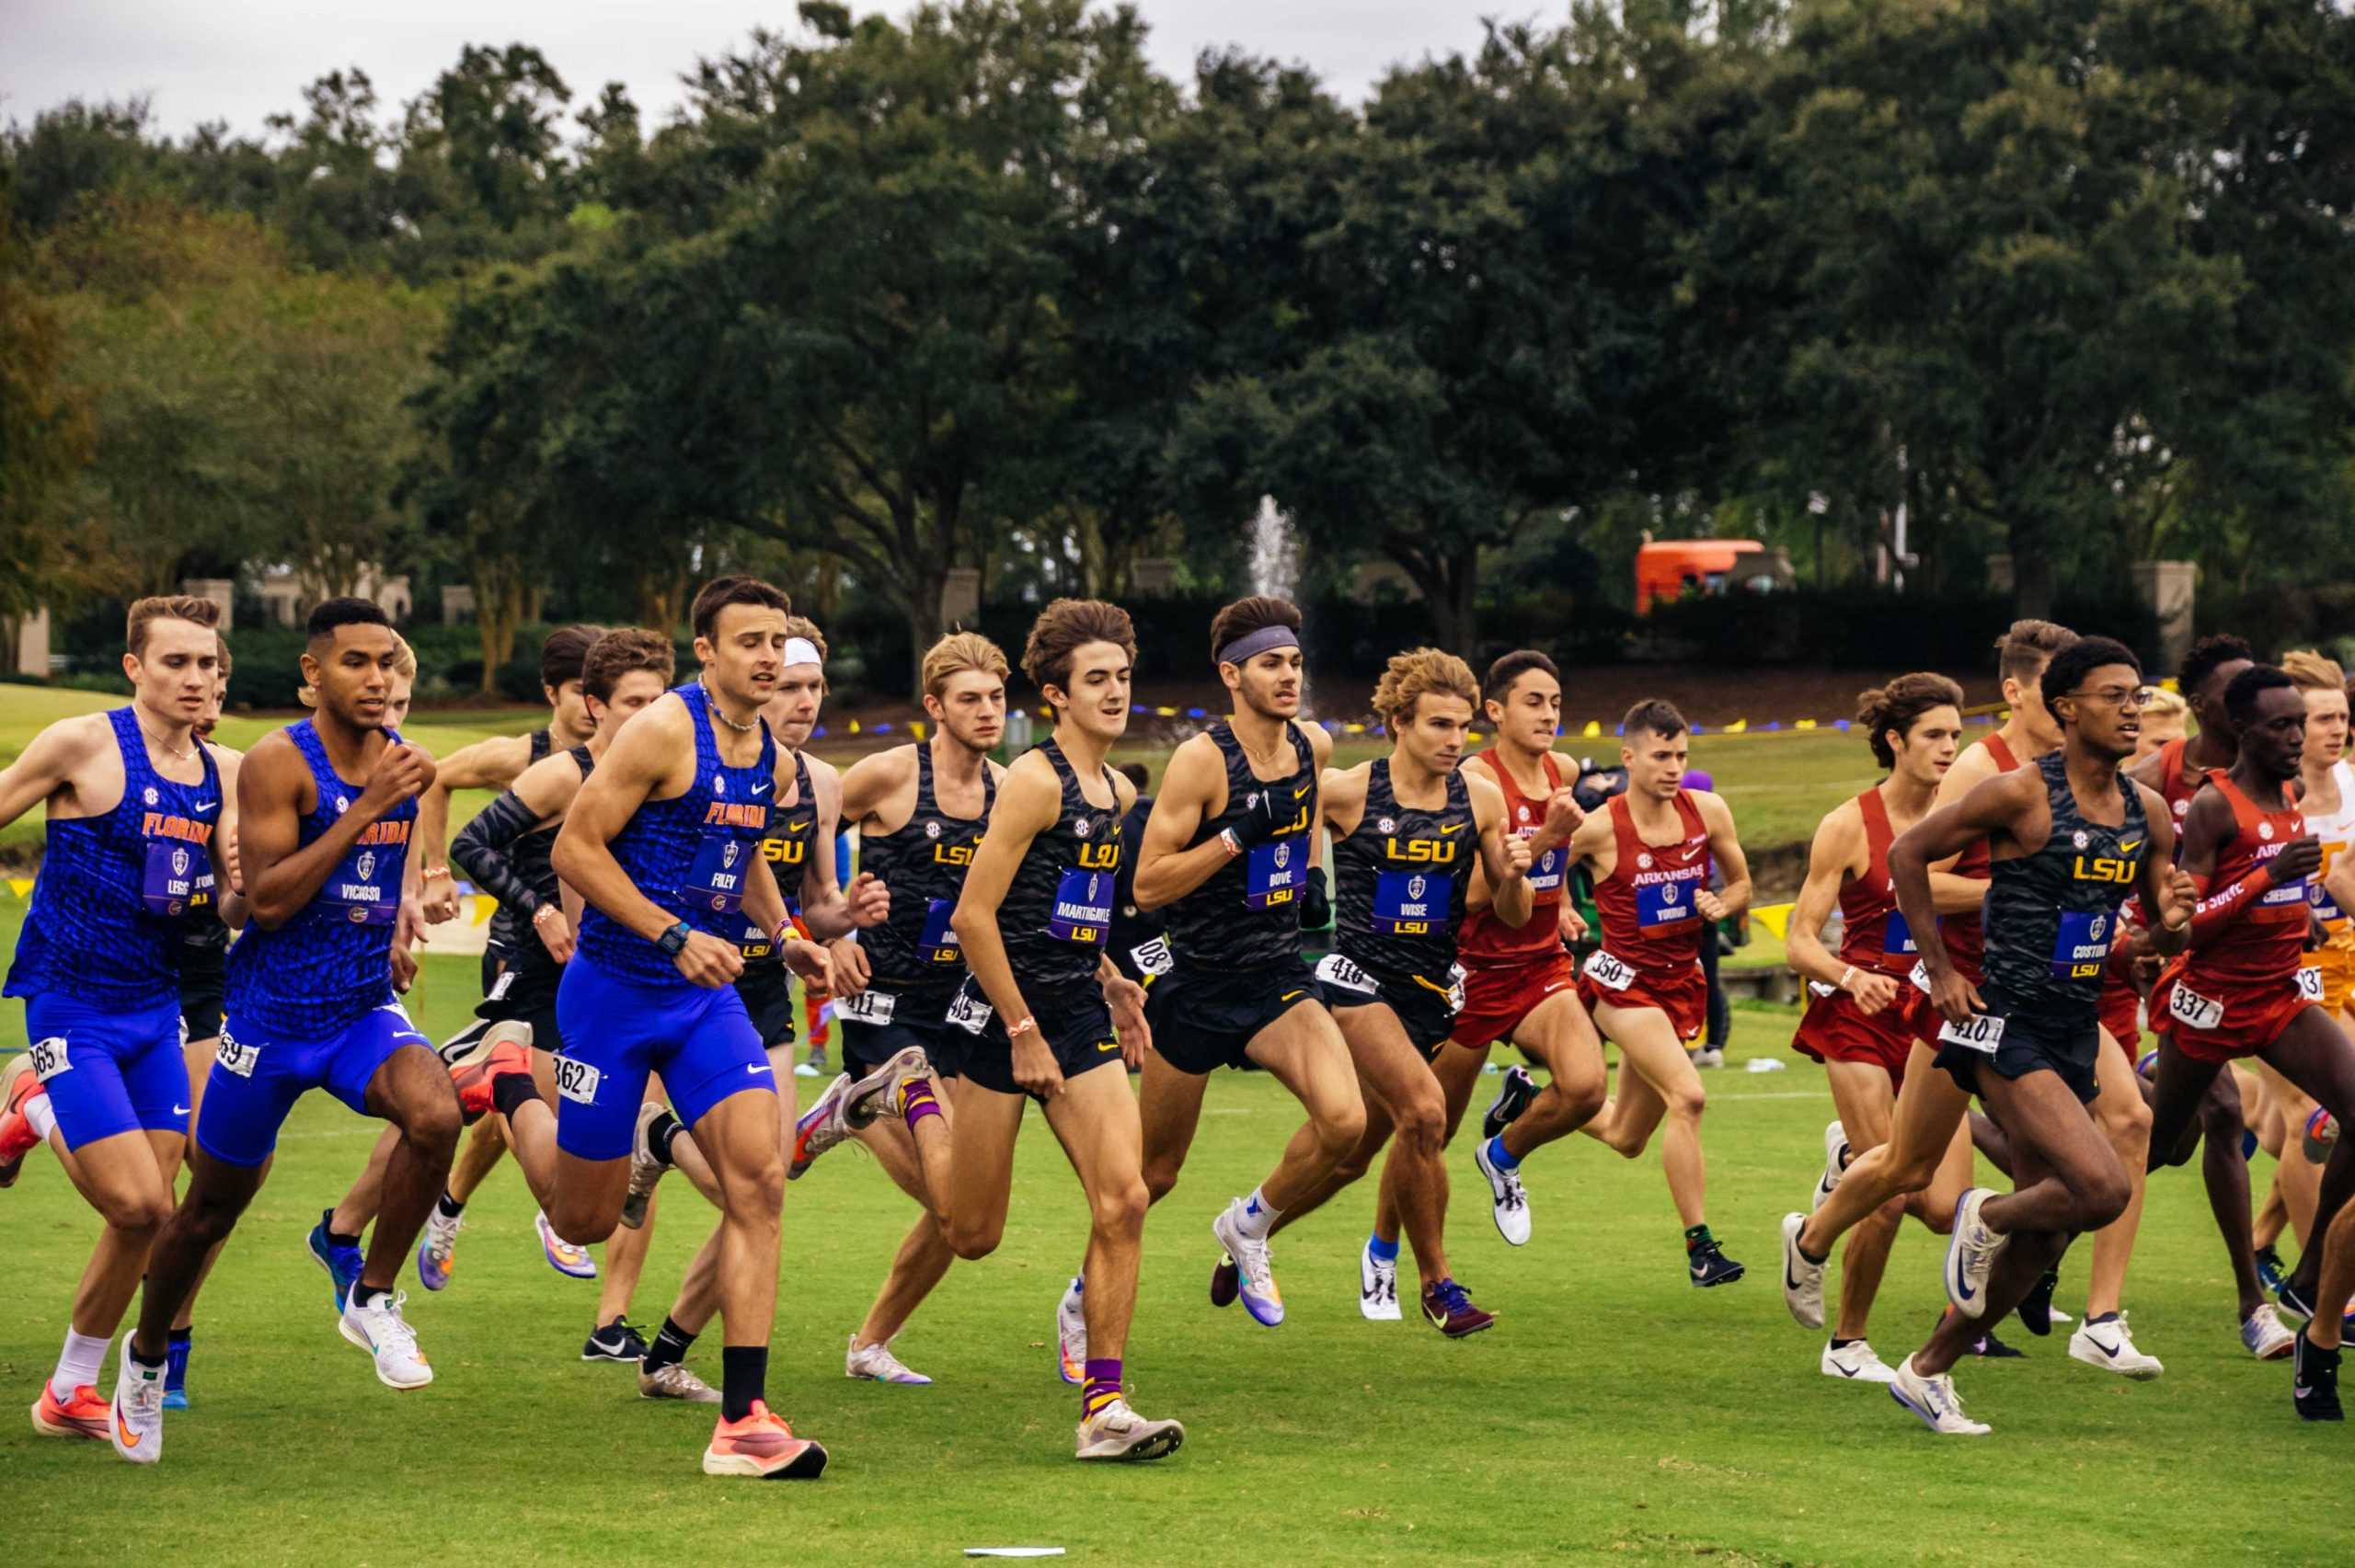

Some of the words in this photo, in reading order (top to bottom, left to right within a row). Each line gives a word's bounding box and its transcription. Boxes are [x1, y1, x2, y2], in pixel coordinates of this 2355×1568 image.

[763, 838, 804, 864] SU
[1078, 842, 1119, 868] LSU
[1387, 838, 1455, 863] LSU
[1634, 863, 1705, 885] ARKANSAS
[2074, 855, 2136, 884] LSU
[711, 873, 737, 889] FOLEY
[1266, 888, 1293, 906] LSU
[1400, 903, 1428, 917] WISE
[1071, 926, 1097, 942] LSU
[1394, 921, 1428, 933] LSU
[743, 945, 771, 957] LSU
[933, 949, 959, 961] LSU
[1138, 941, 1167, 967] 08
[1592, 954, 1623, 982] 350
[2072, 964, 2099, 978] LSU
[2173, 988, 2209, 1021] 337
